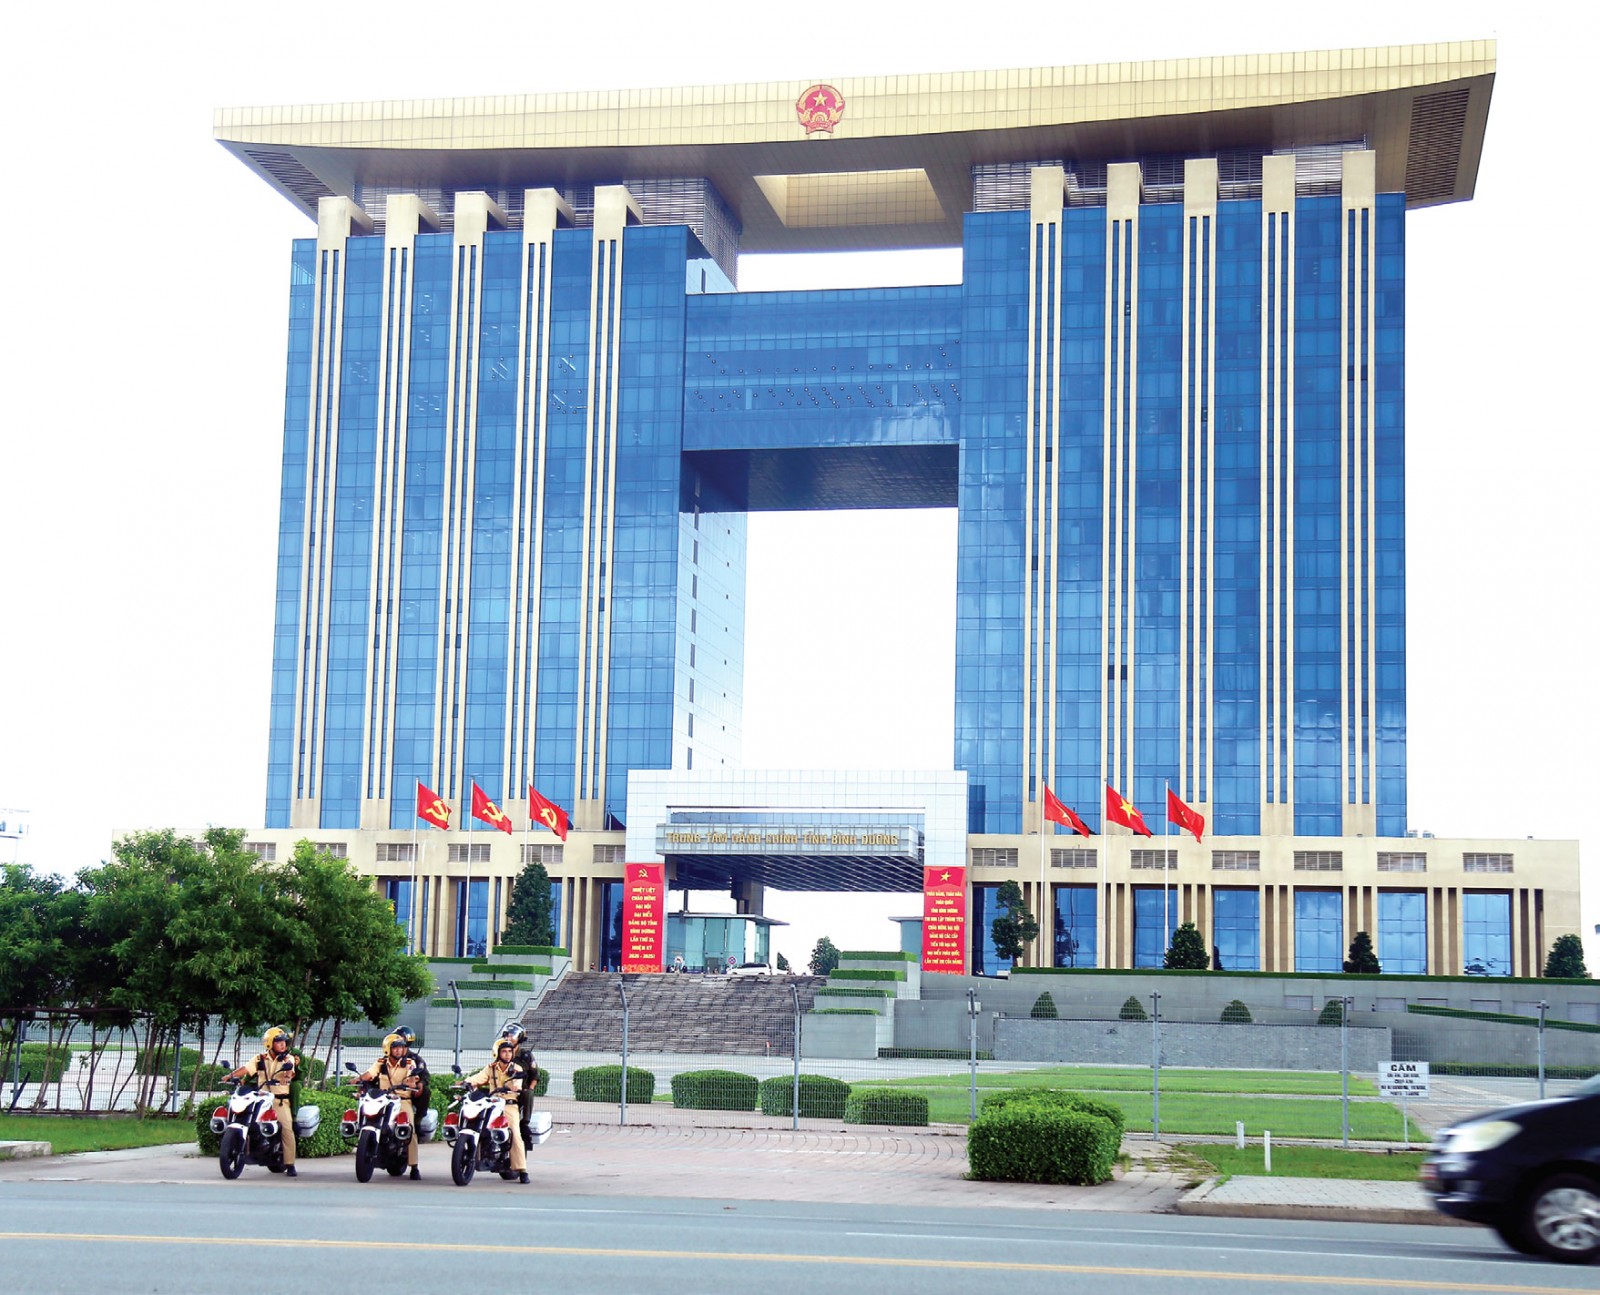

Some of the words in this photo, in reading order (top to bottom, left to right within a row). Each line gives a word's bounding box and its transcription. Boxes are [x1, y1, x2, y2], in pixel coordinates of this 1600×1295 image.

[666, 832, 700, 844] TRUNG
[706, 831, 728, 844] TÂM
[732, 832, 761, 844] HÀNH
[766, 832, 798, 845] CHÍNH
[831, 832, 857, 845] BÌNH
